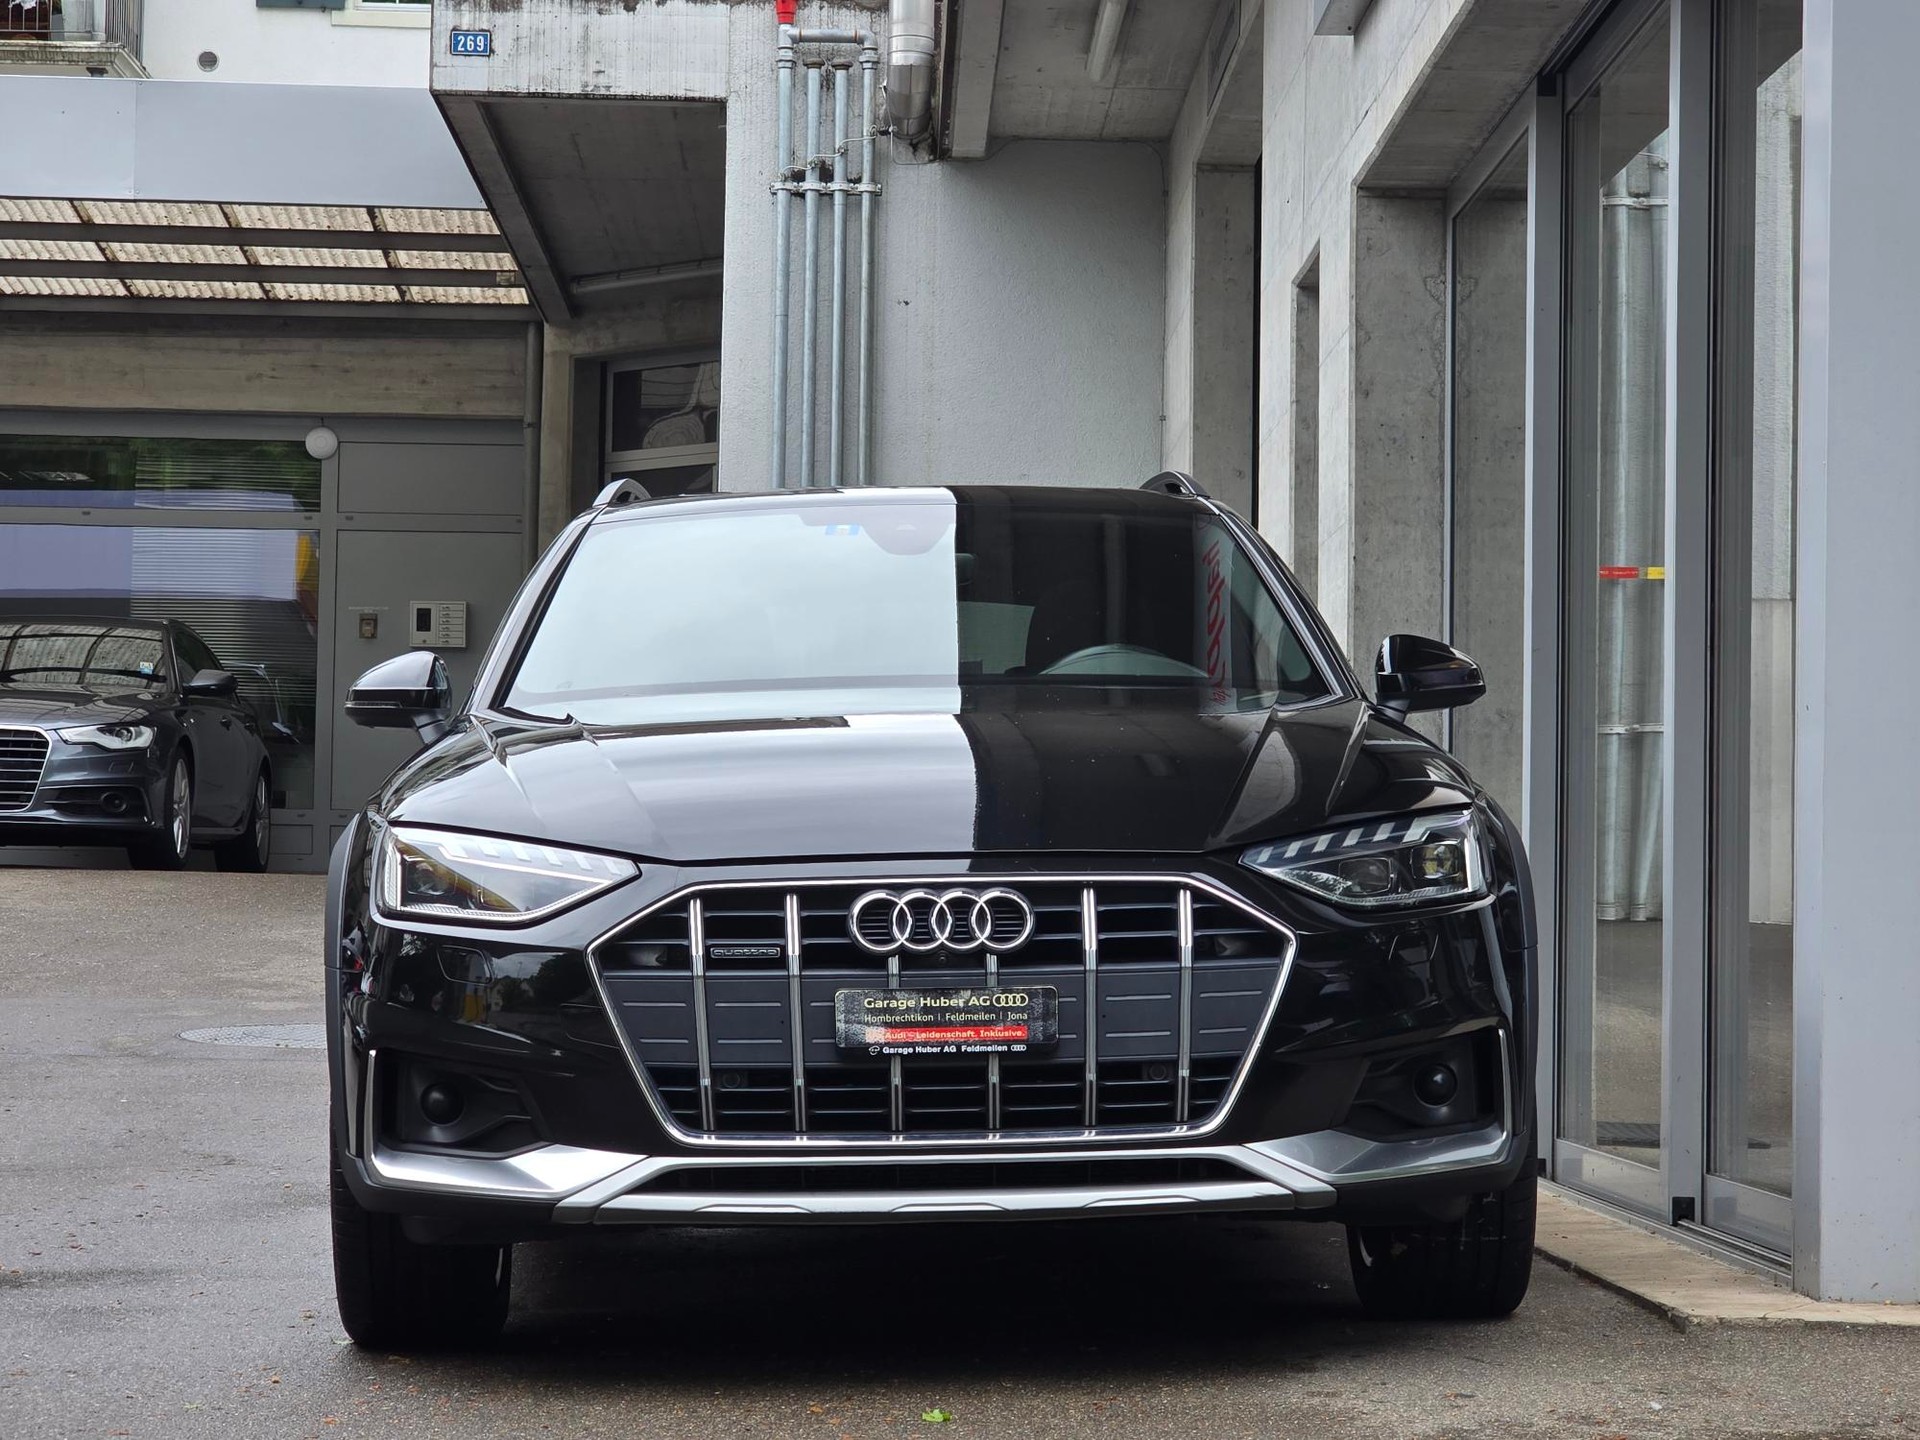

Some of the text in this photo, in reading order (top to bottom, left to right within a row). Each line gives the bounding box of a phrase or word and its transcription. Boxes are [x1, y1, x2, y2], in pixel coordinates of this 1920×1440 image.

[457, 35, 485, 51] 269
[863, 995, 991, 1010] Garage Huber AG
[864, 1011, 1028, 1023] Hombrechtikon Feldmeilen Jona
[980, 1028, 1026, 1037] Inklusive.
[882, 1044, 1008, 1055] Garage Huber AG Feldmeilen
